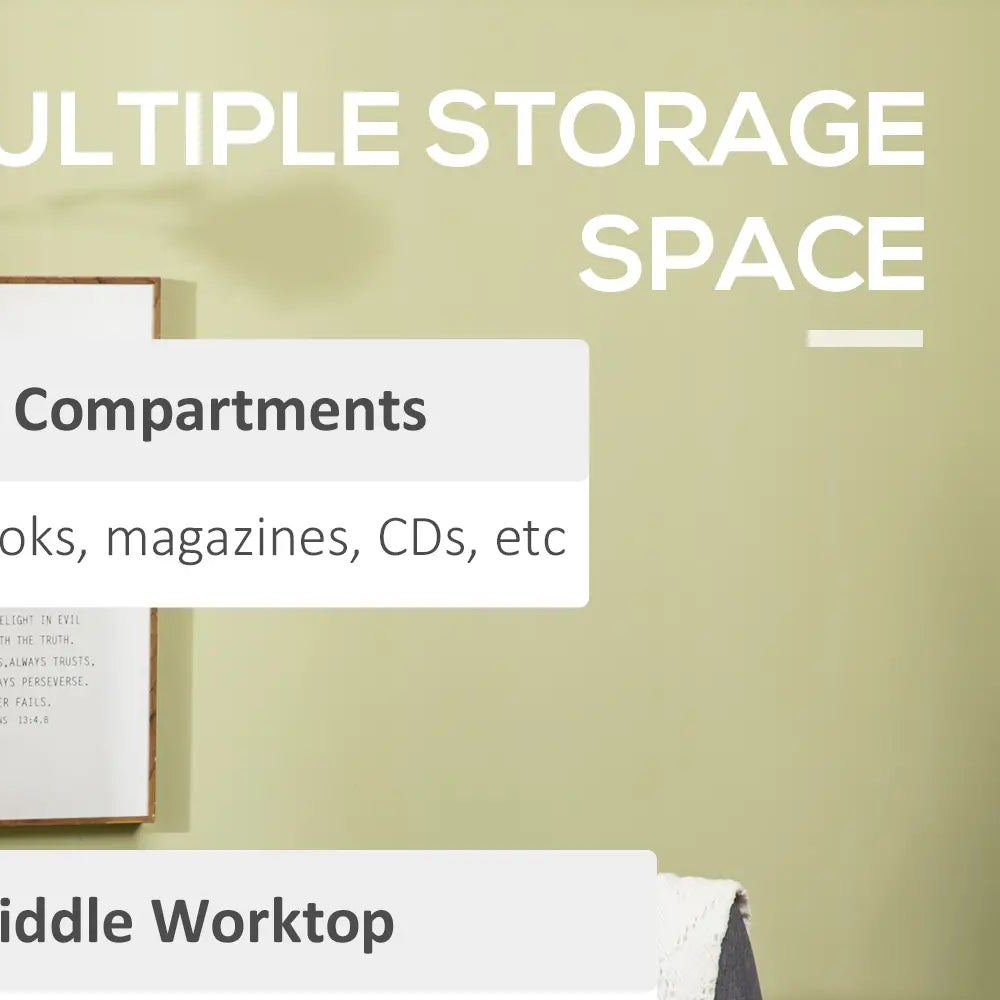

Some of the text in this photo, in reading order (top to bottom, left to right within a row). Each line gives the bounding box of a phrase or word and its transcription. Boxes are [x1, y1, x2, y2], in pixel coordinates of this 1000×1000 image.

[41, 615, 52, 625] IN
[57, 614, 80, 625] EVIL
[16, 635, 33, 646] THE
[39, 635, 75, 646] TRUTH.
